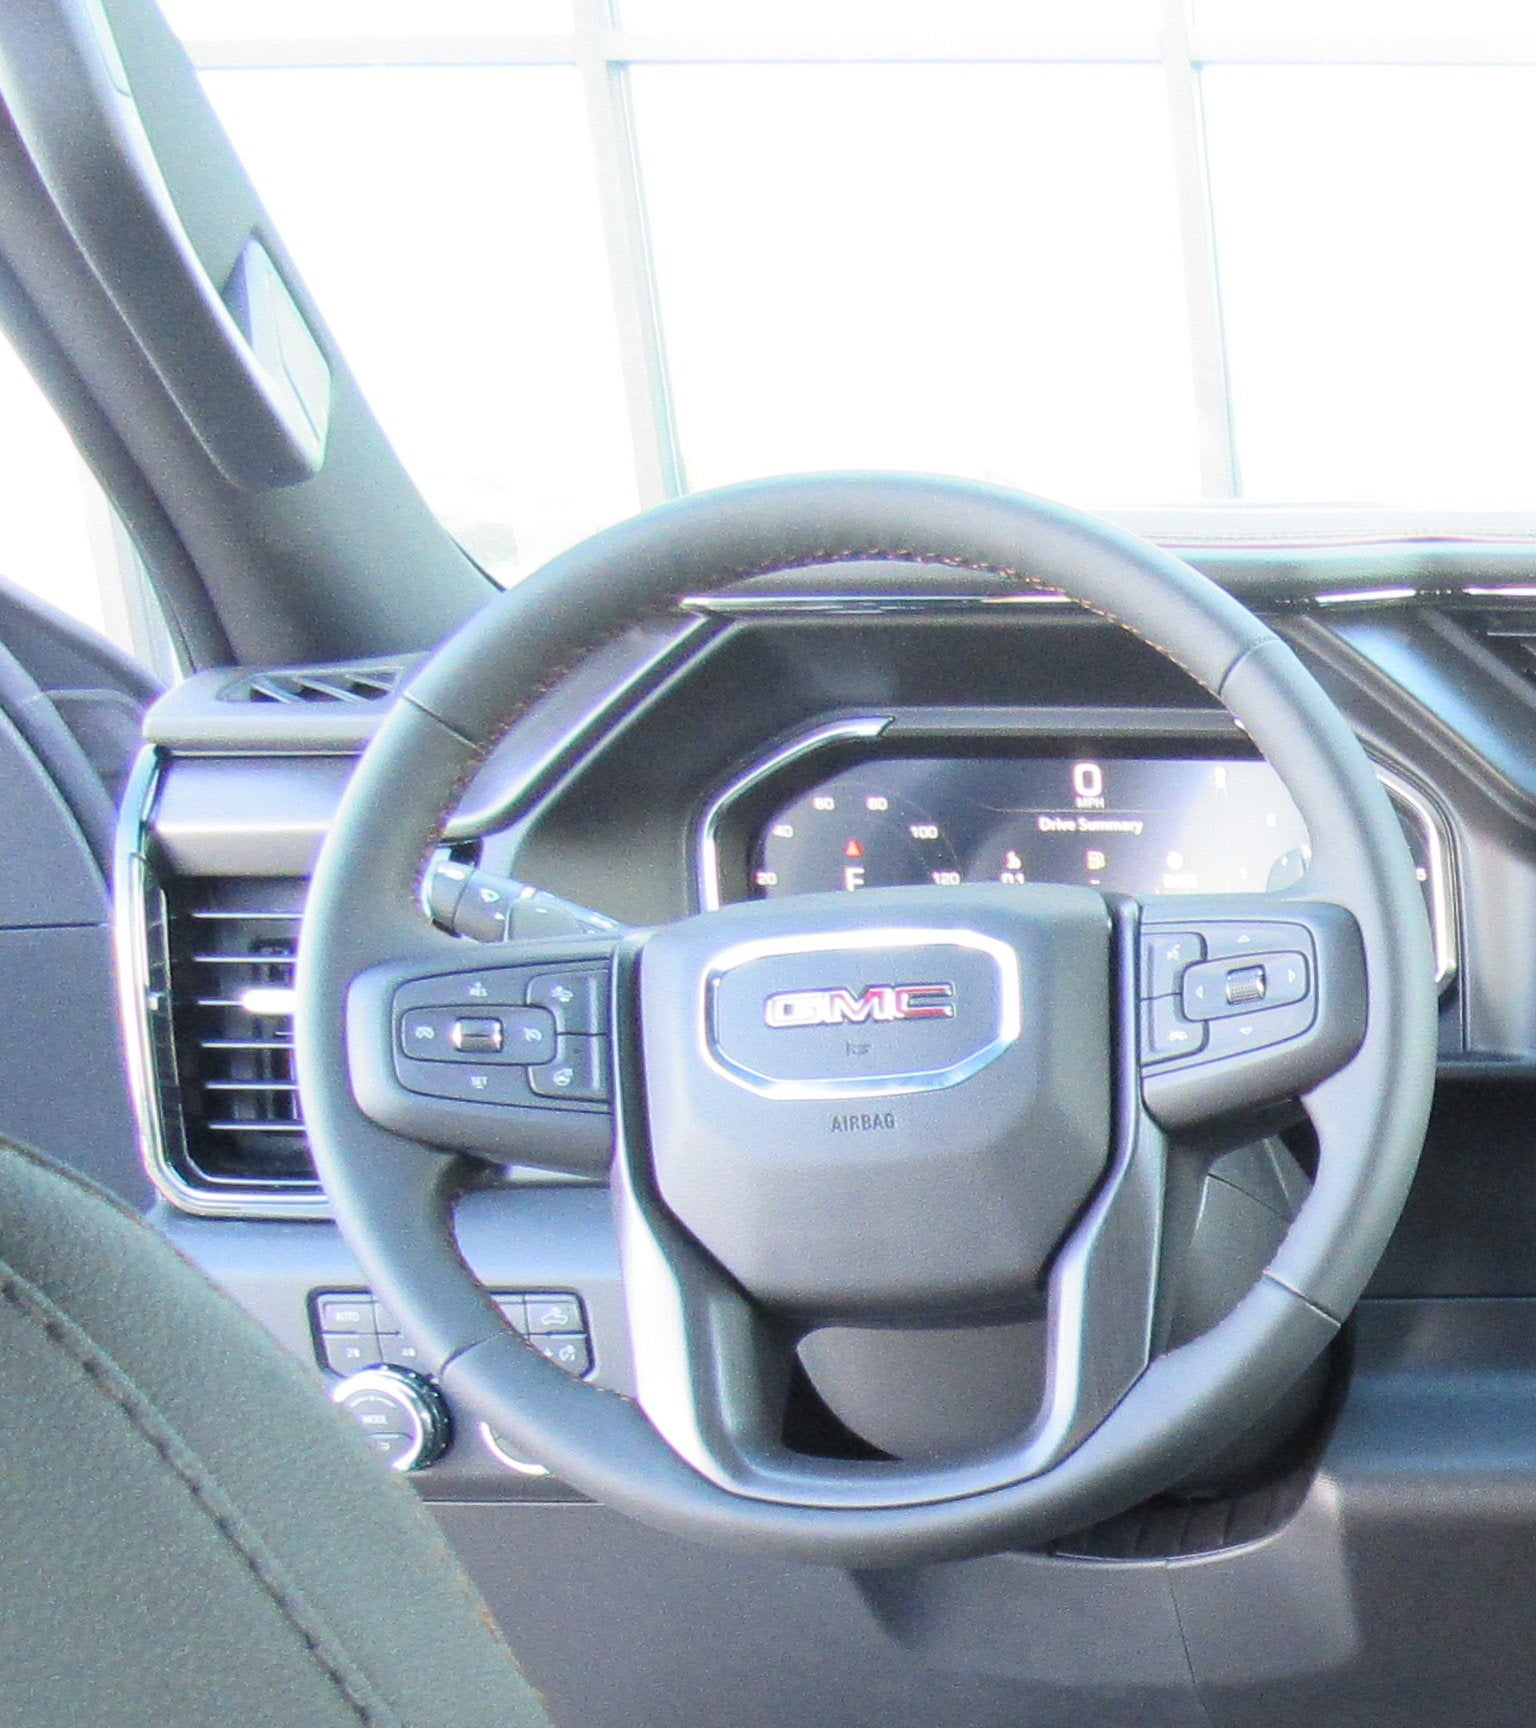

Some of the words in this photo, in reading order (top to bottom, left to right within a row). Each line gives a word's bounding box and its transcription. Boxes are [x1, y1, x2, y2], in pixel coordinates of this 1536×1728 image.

[1073, 762, 1102, 797] 0
[1075, 797, 1104, 809] MPH
[772, 824, 793, 838] 40
[909, 825, 938, 839] 100
[1037, 816, 1076, 832] Drive
[1077, 817, 1144, 835] Summary
[765, 980, 956, 1029] GMC
[831, 1112, 895, 1133] AIRBAG
